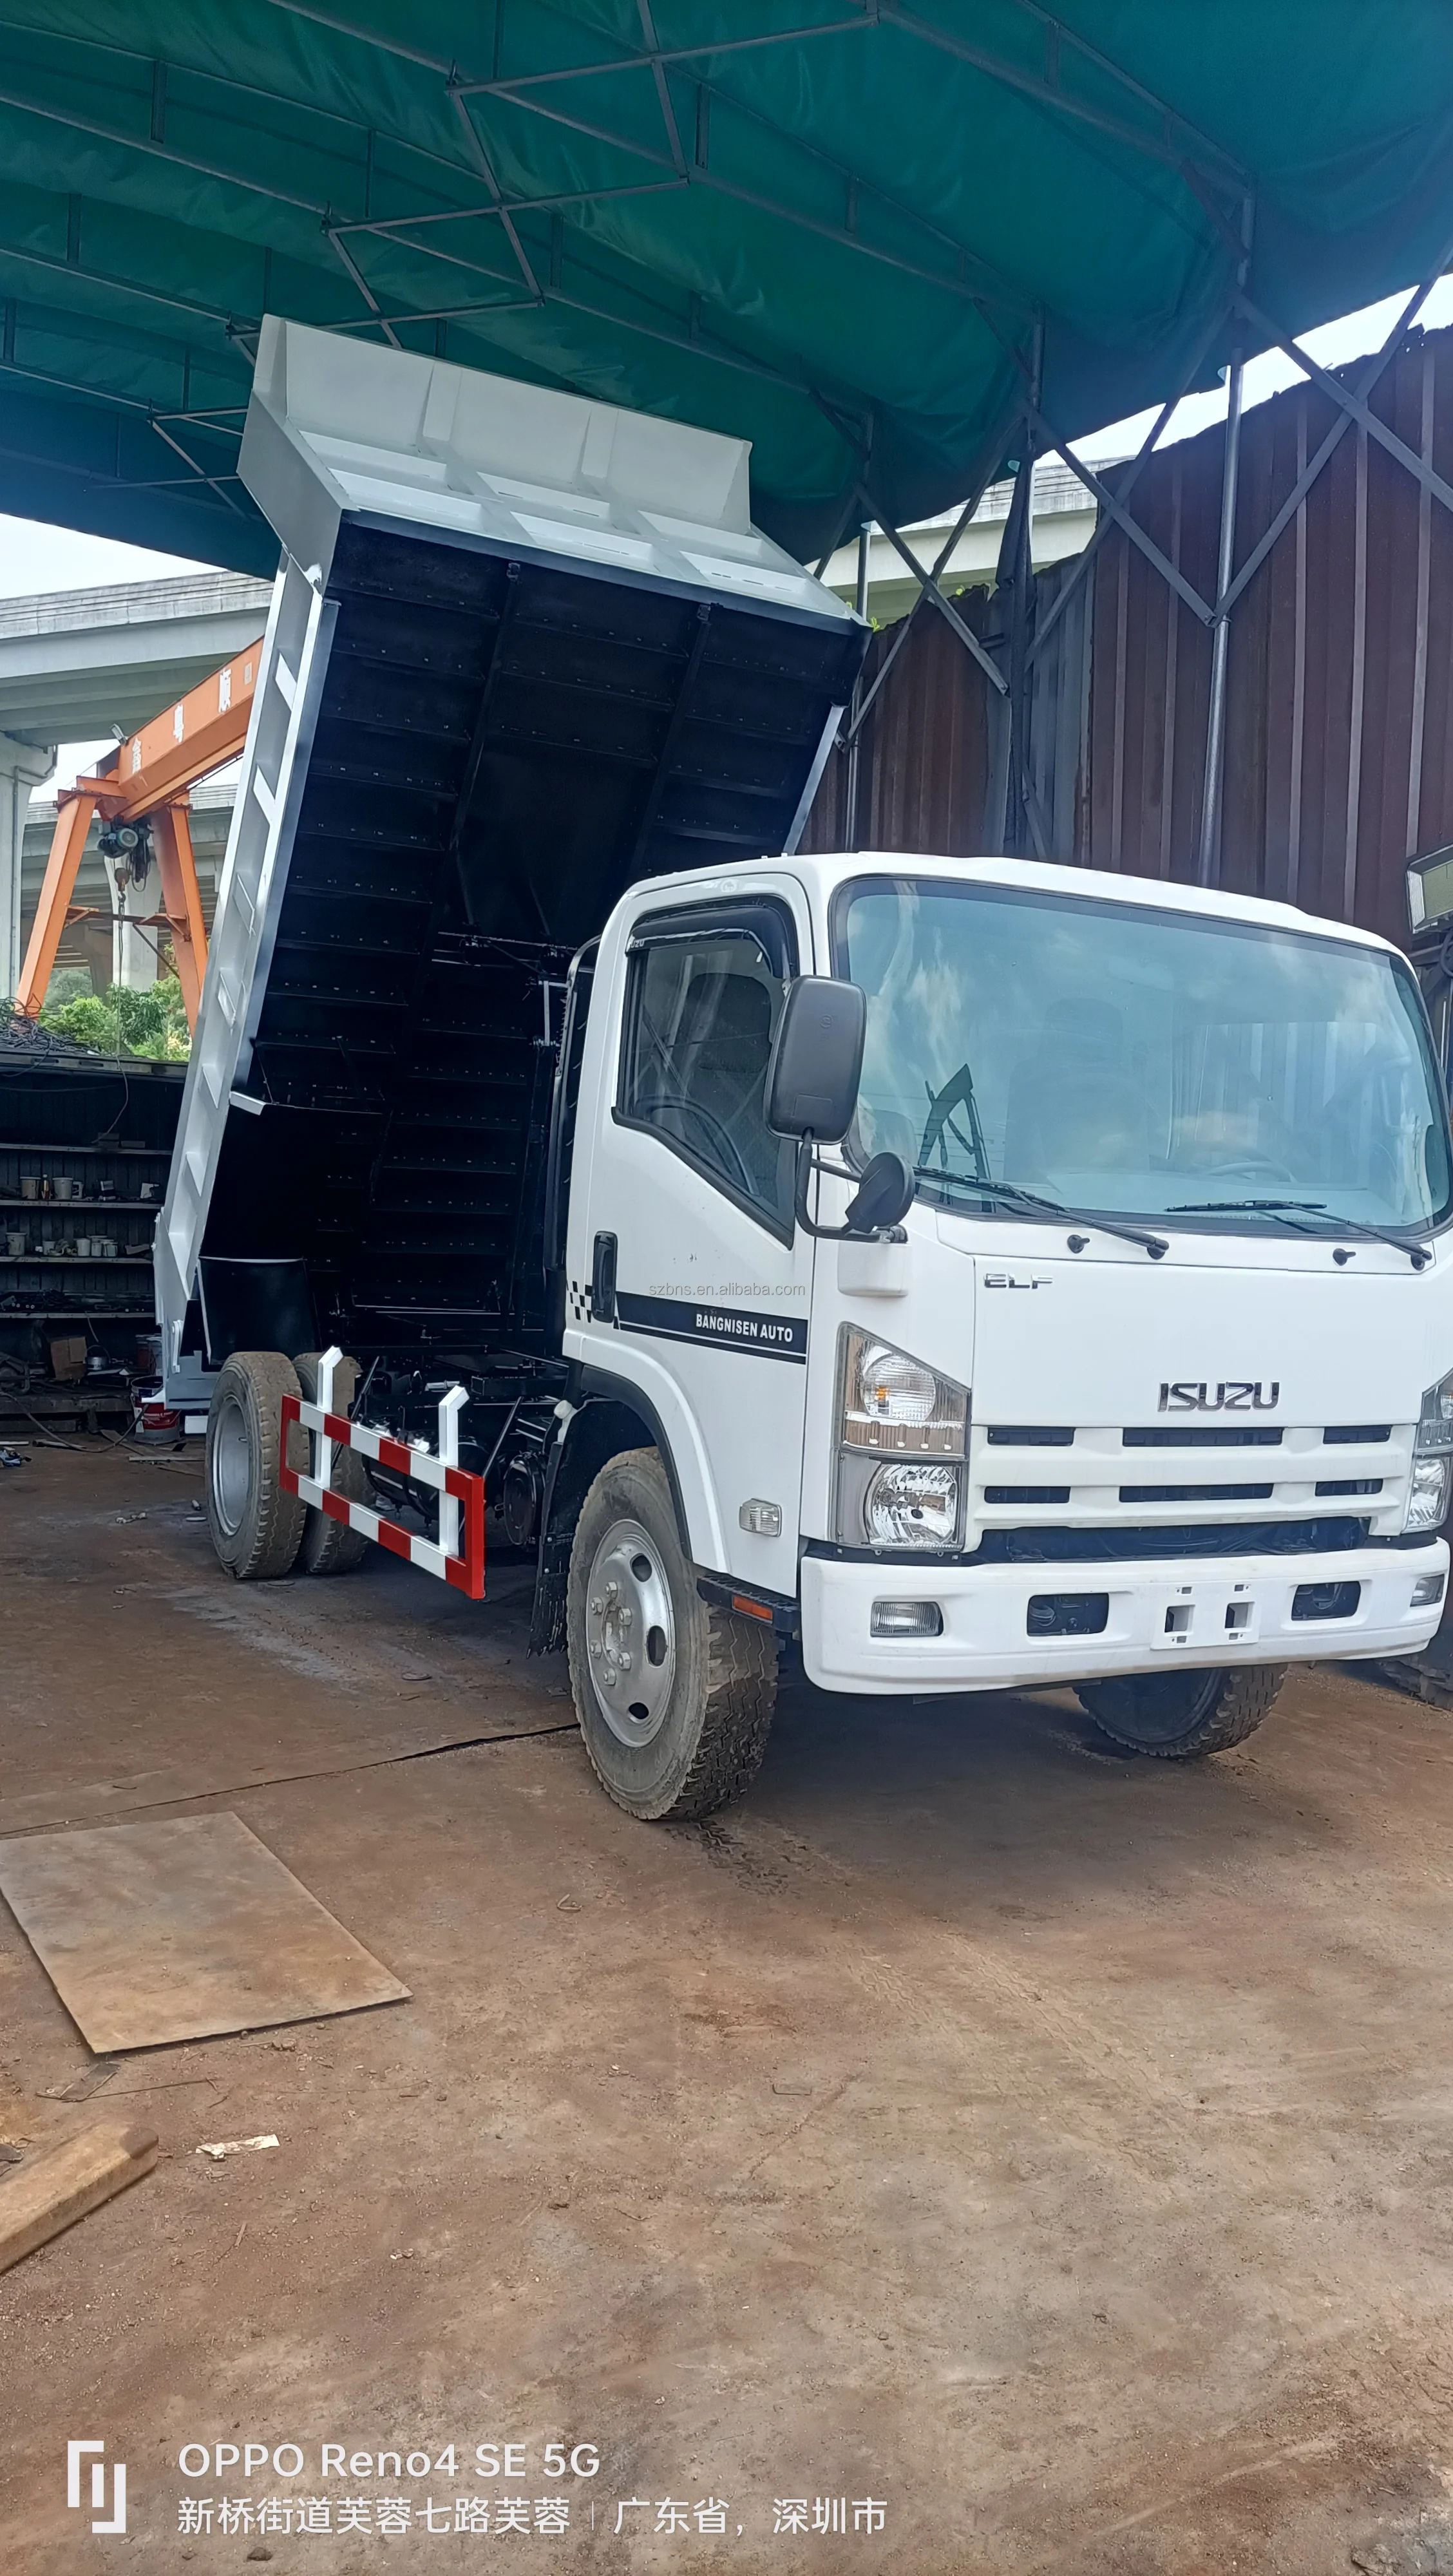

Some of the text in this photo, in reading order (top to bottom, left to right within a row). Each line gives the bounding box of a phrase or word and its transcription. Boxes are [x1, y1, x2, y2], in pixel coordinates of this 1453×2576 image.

[983, 1273, 1054, 1289] ELF
[696, 1313, 793, 1343] BANGNISEN AUTO
[1158, 1381, 1280, 1412] ISUZU
